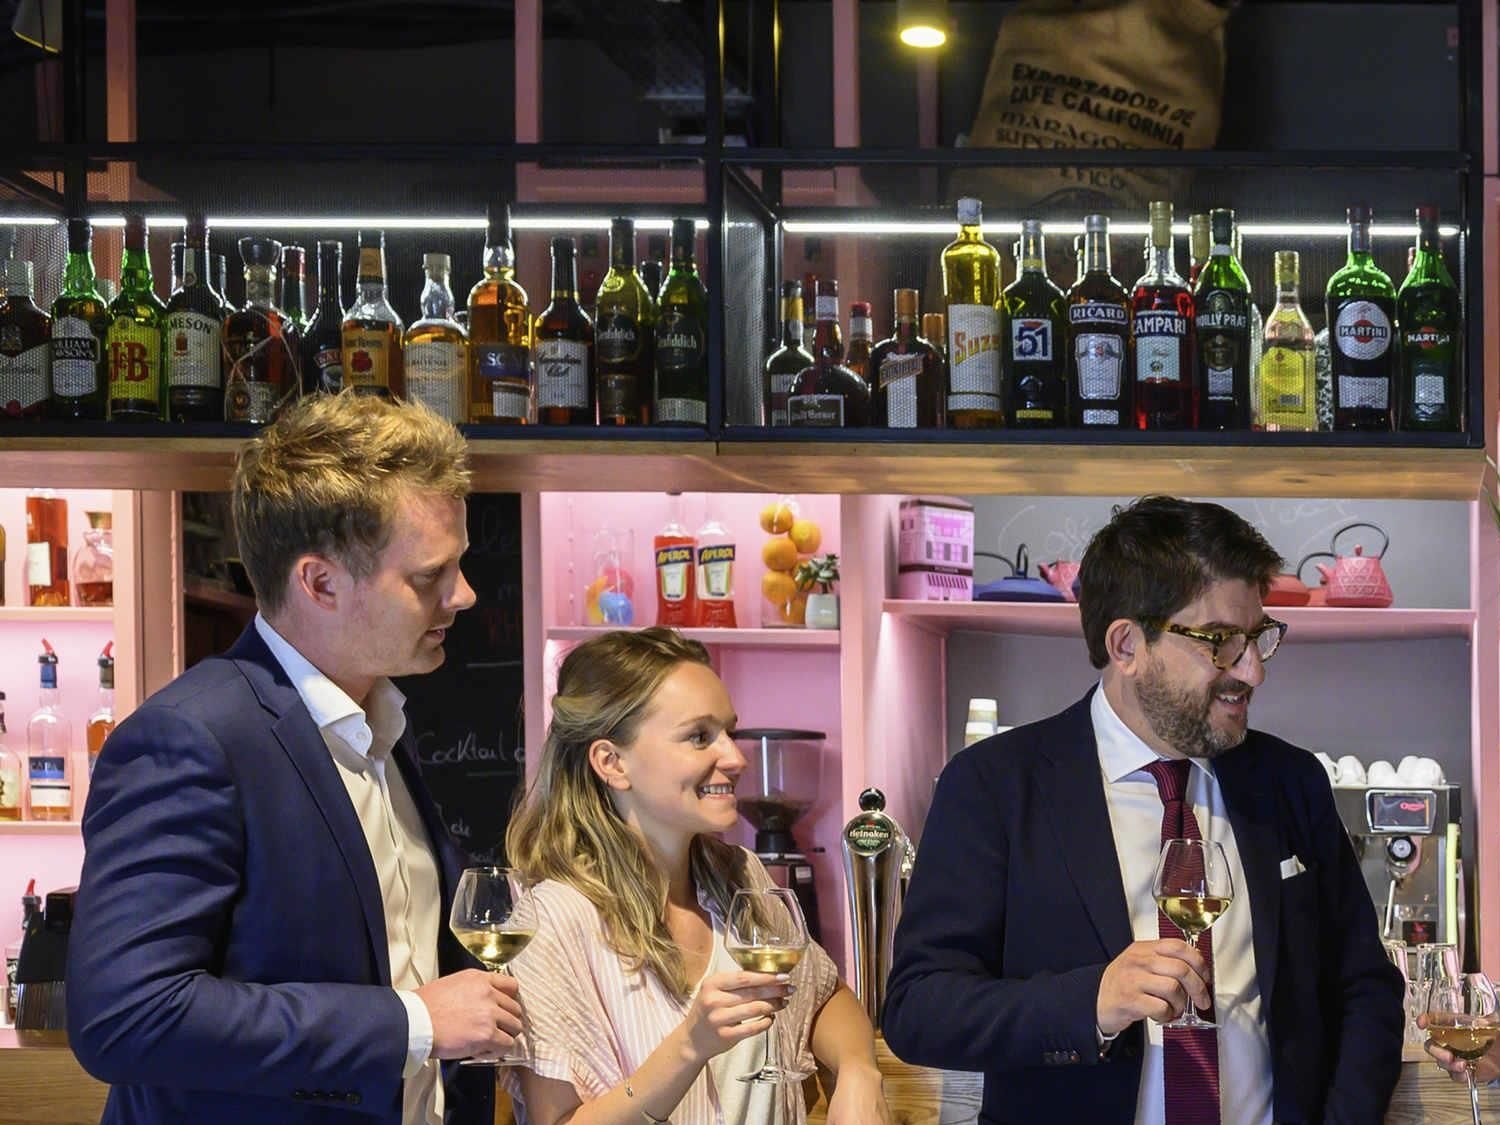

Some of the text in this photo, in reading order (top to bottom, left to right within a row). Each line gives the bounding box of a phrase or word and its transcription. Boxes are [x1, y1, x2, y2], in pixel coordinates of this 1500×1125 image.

[1000, 111, 1142, 150] MARAGO
[1061, 90, 1184, 150] CALIFORNIA
[1071, 304, 1126, 320] RICARD
[1016, 324, 1049, 358] 51
[1338, 323, 1387, 338] MARTINI
